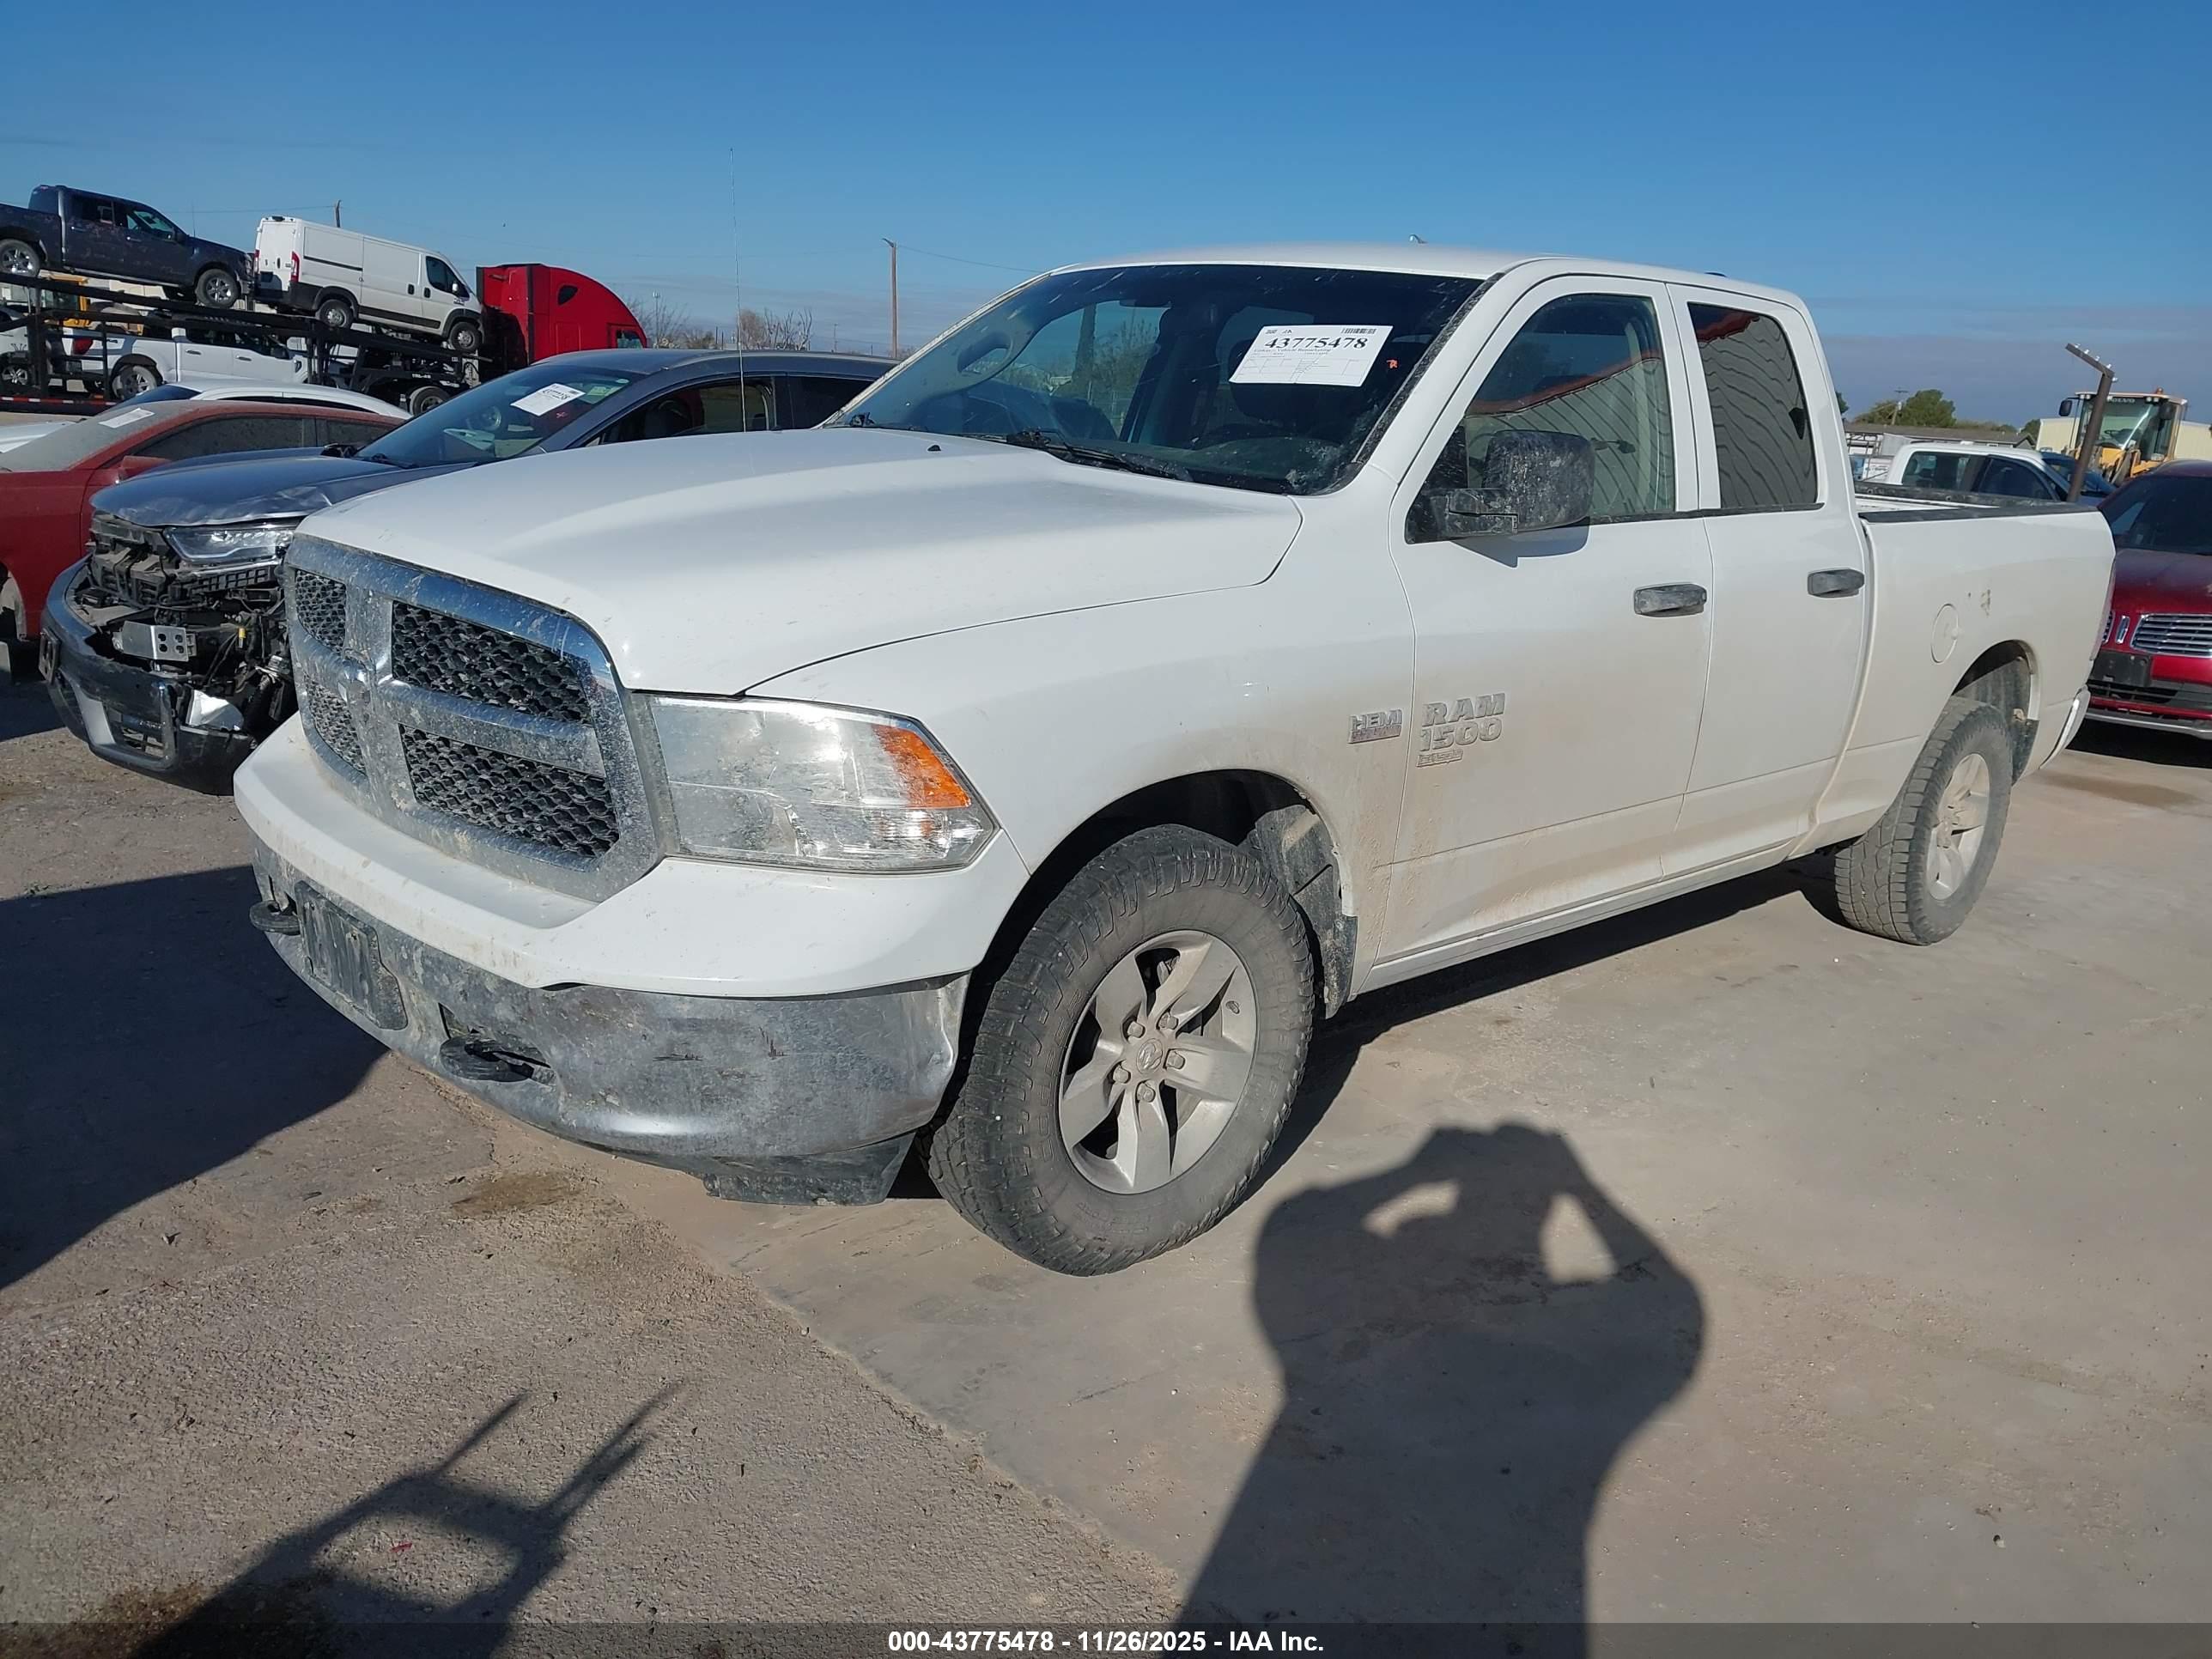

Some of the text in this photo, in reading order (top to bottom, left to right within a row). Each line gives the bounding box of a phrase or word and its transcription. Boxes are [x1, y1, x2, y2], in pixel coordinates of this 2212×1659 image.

[1264, 337, 1368, 349] 43775478
[1350, 708, 1402, 730] HEMI
[1421, 692, 1505, 727] RAM
[1419, 718, 1503, 752] 1500
